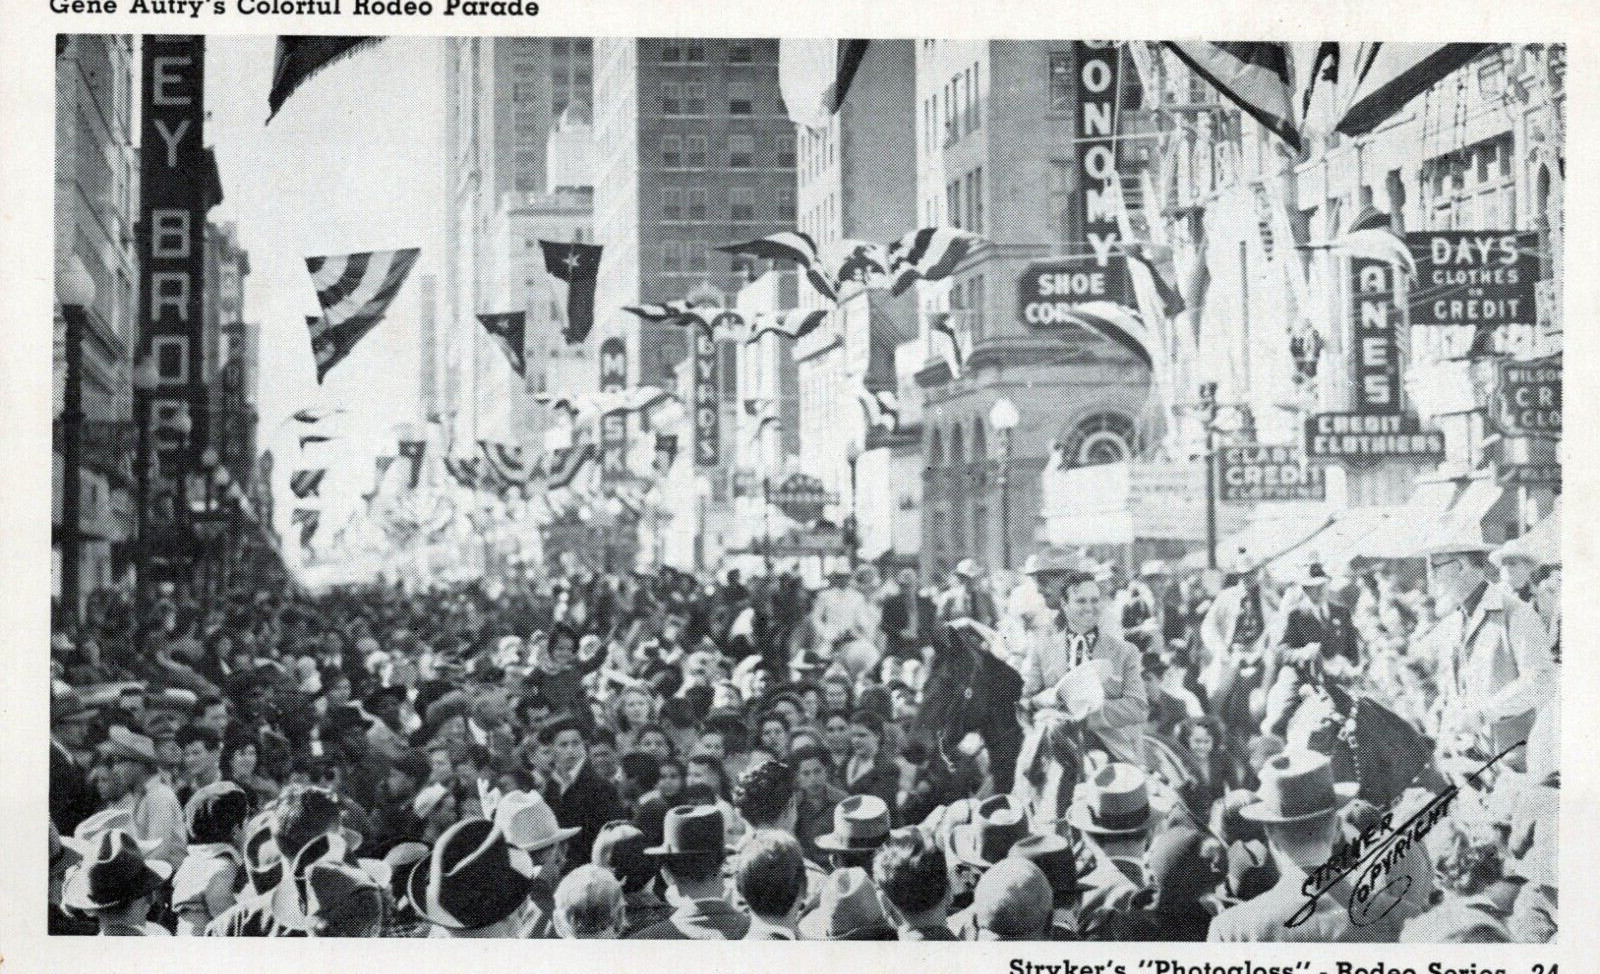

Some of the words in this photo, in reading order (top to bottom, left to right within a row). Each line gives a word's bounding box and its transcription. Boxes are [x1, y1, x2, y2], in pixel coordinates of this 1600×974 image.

[152, 35, 193, 167] EY
[1081, 40, 1118, 267] ONOMY
[1431, 236, 1519, 266] DAYS
[1037, 272, 1106, 297] SHOE
[1431, 269, 1519, 285] CLOTHES
[1433, 299, 1520, 321] CREDIT
[1317, 415, 1401, 434] CREDIT
[1225, 464, 1321, 486] CREDIT
